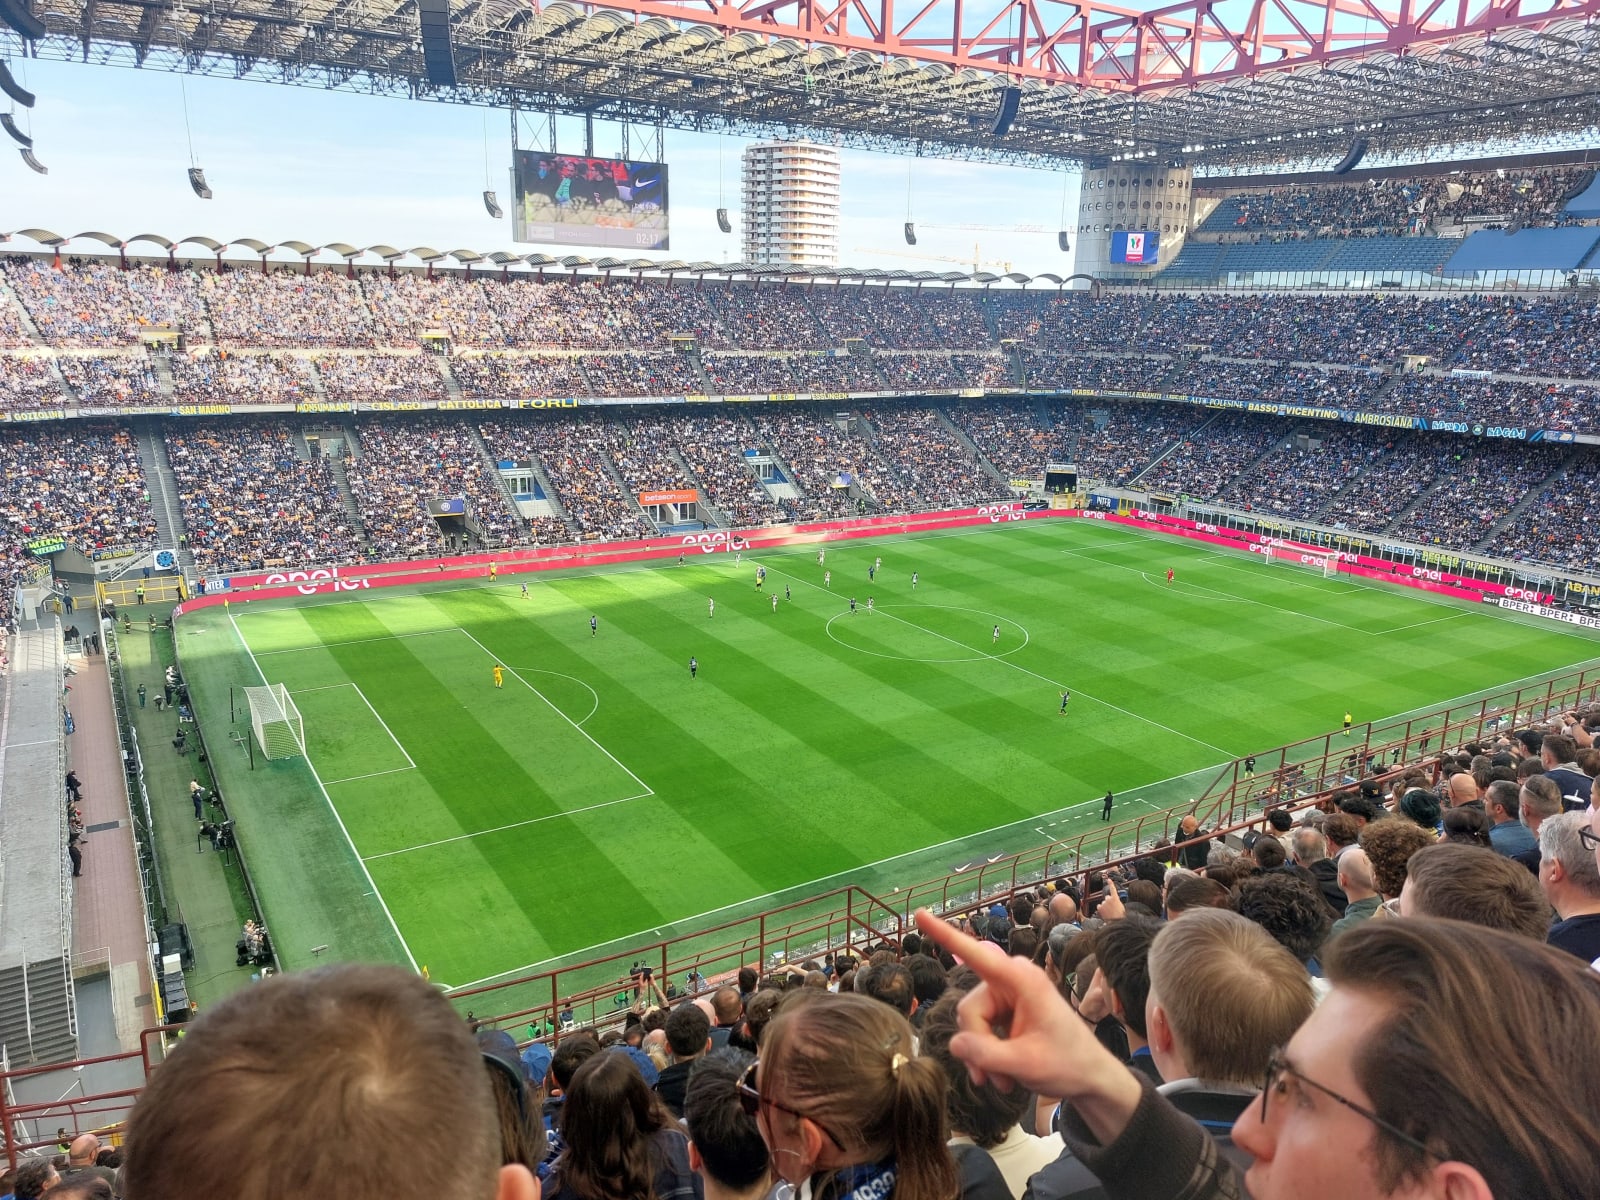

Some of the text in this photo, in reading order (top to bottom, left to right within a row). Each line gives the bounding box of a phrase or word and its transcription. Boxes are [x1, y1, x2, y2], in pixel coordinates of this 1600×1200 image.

[636, 232, 659, 245] 02:17
[179, 405, 196, 415] SAN
[198, 404, 231, 415] MARINO
[371, 402, 421, 410] CISLAGO
[437, 400, 502, 410] CATTOLICA
[1247, 402, 1339, 420] BASSO VICENTINO
[1354, 412, 1413, 429] AMBROSIANA
[645, 493, 676, 502] betsson
[1083, 510, 1106, 520] enel
[1138, 509, 1157, 520] enel
[1196, 522, 1217, 533] enel
[1412, 566, 1442, 581] enel
[1504, 585, 1540, 603] enel
